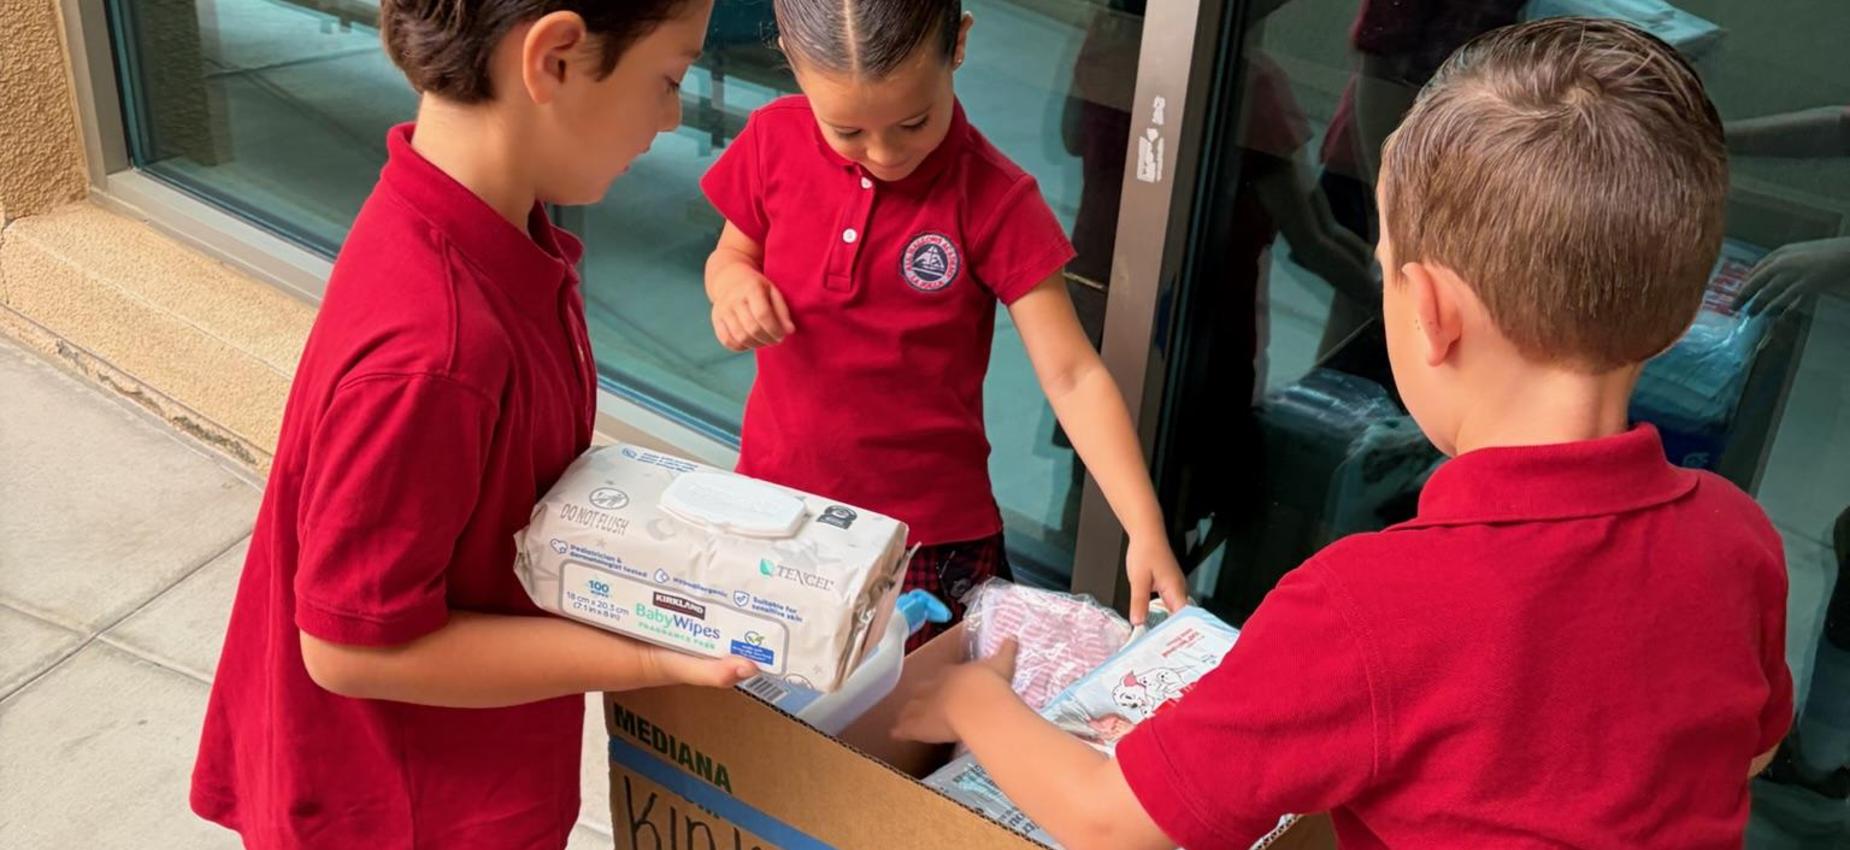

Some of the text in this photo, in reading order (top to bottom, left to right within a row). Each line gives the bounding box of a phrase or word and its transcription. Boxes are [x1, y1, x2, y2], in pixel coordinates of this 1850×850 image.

[560, 503, 629, 537] DO NOT FLUSH
[623, 565, 648, 578] tested
[777, 564, 831, 592] TENCEL
[588, 580, 610, 593] 100
[567, 591, 576, 601] 18
[577, 595, 590, 604] cm
[615, 606, 630, 617] cm
[655, 593, 704, 615] KIRKLAND
[751, 604, 785, 618] sensitive
[752, 595, 797, 614] Suitable for
[613, 703, 732, 793] MEDIANA
